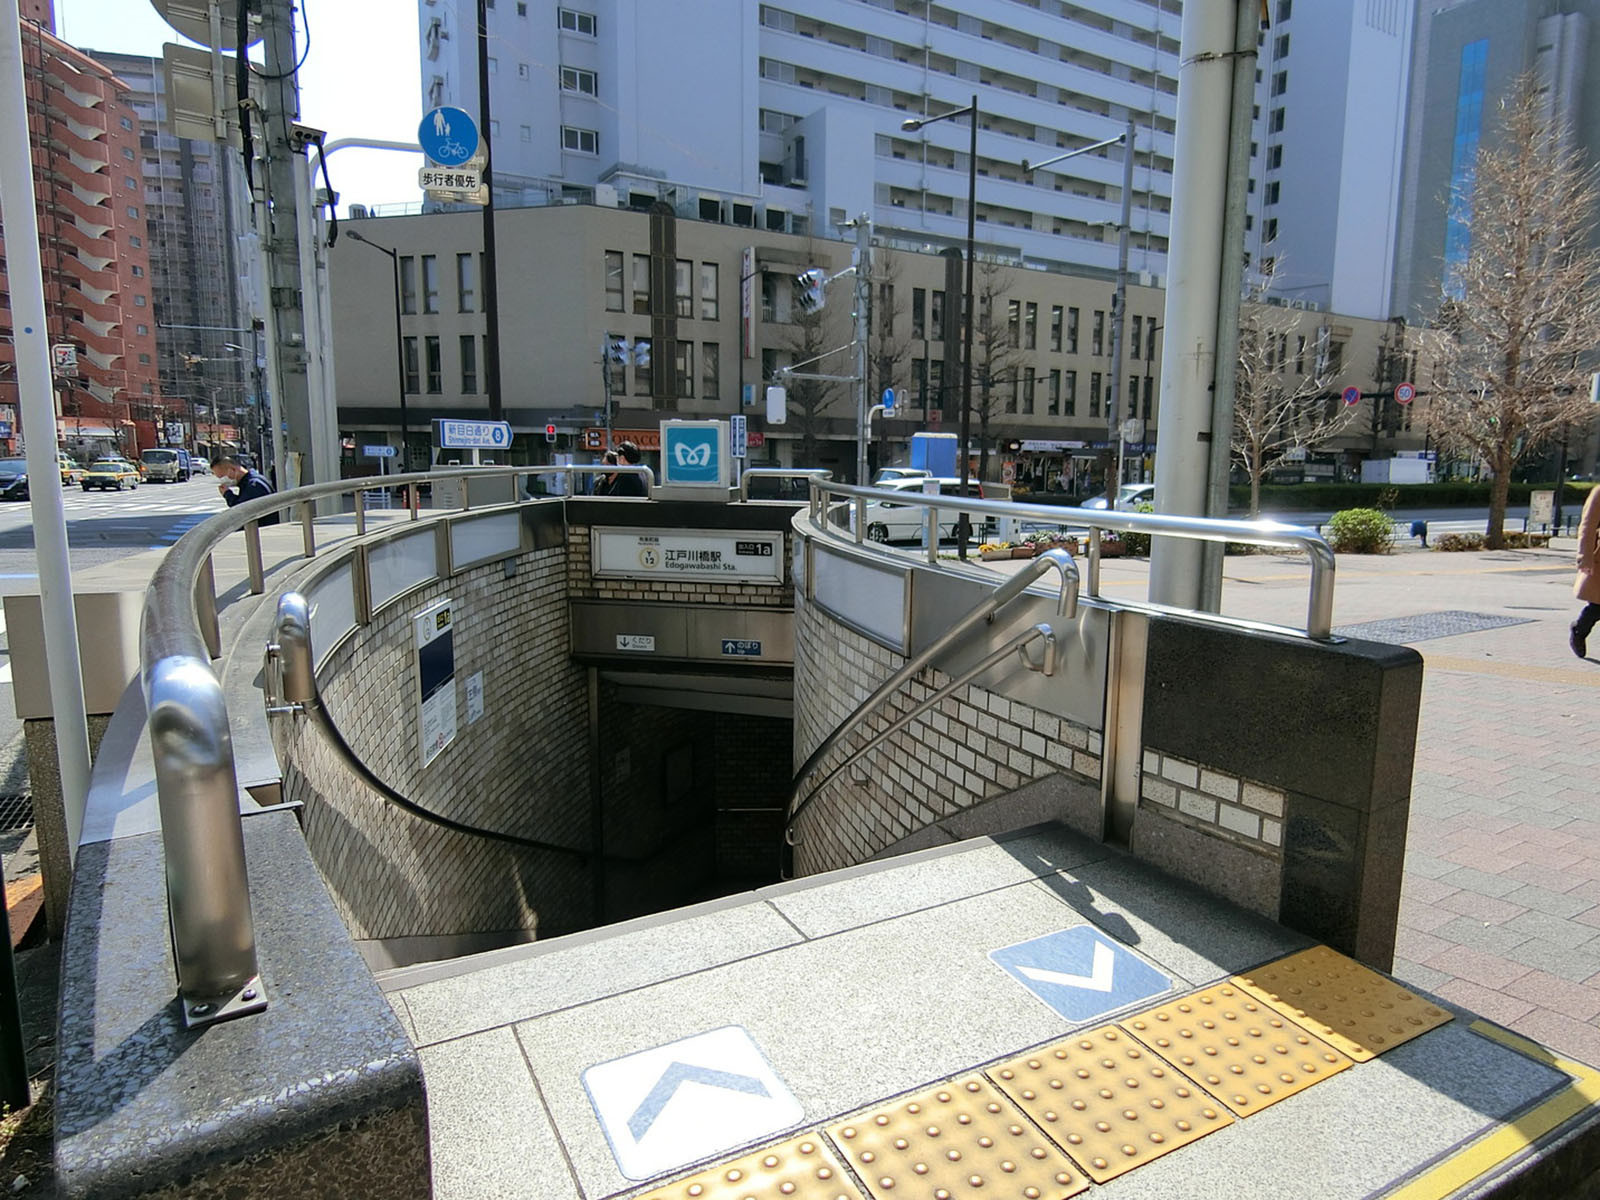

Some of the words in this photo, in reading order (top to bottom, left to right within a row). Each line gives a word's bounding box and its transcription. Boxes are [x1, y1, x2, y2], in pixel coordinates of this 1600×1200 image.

[423, 172, 476, 188] 歩行者優先
[448, 424, 490, 437] 新目白通り
[756, 543, 771, 555] 1a
[664, 549, 722, 562] 江戸川橋駅
[664, 561, 721, 571] Edogawabashi
[722, 563, 737, 571] Sta.
[737, 641, 759, 649] のぼり
